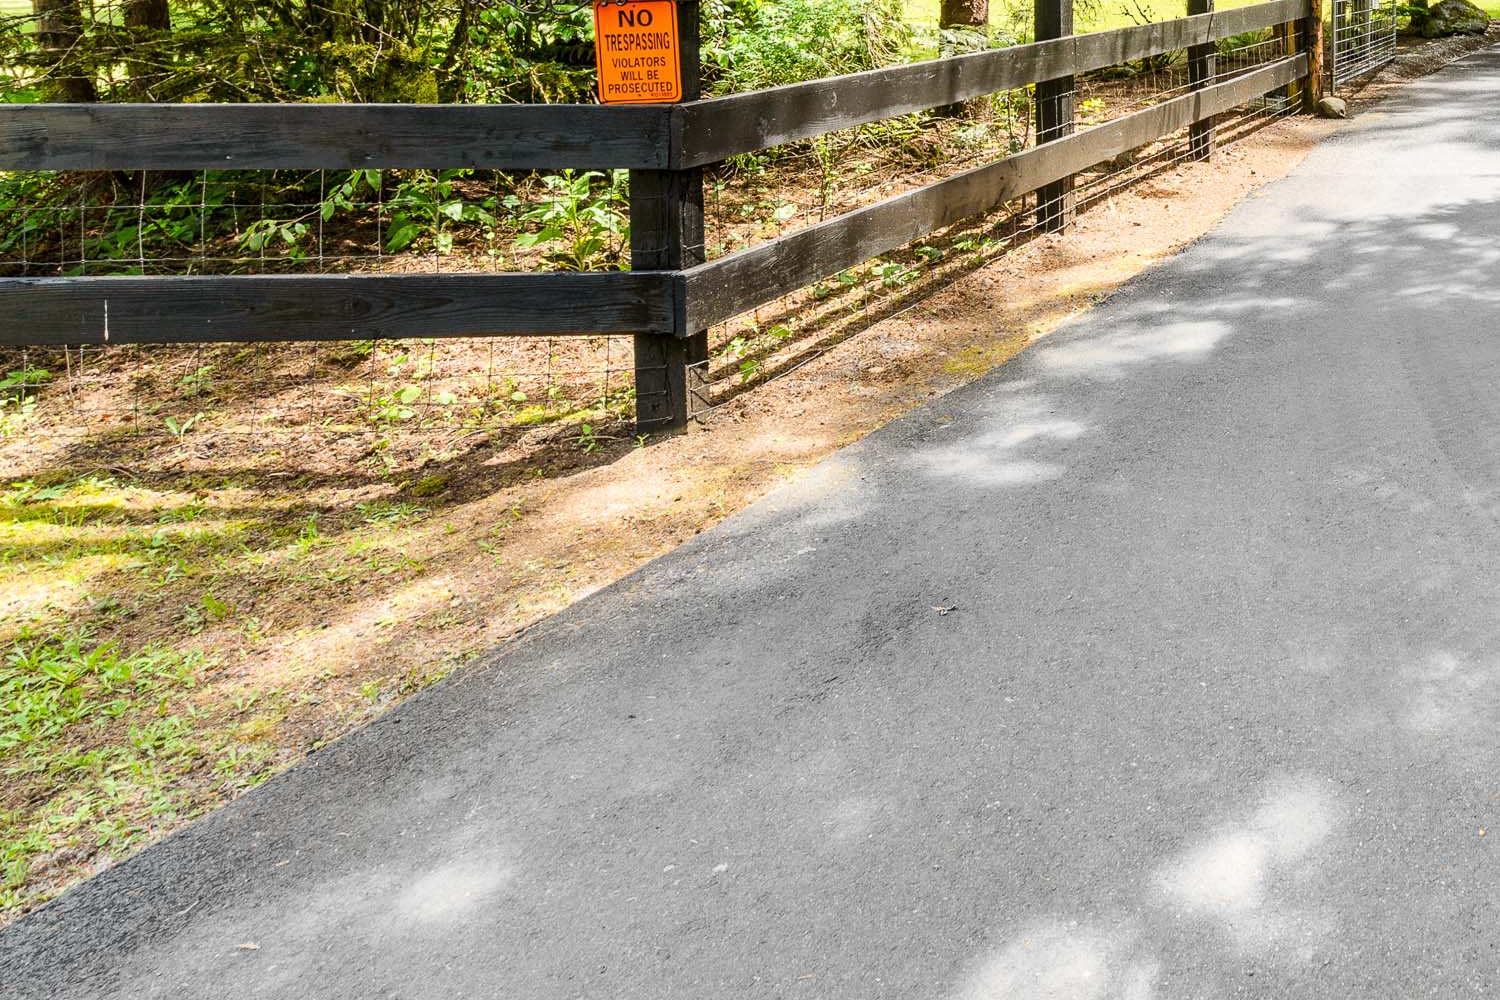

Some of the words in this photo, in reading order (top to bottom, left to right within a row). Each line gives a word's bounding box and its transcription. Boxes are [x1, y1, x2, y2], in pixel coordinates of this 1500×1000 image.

[618, 9, 653, 28] NO
[604, 32, 670, 52] TRESPASSING
[612, 56, 666, 68] VIOLATORS
[620, 71, 644, 81] WILL
[647, 70, 660, 80] BE
[608, 81, 673, 94] PROSECUTED
